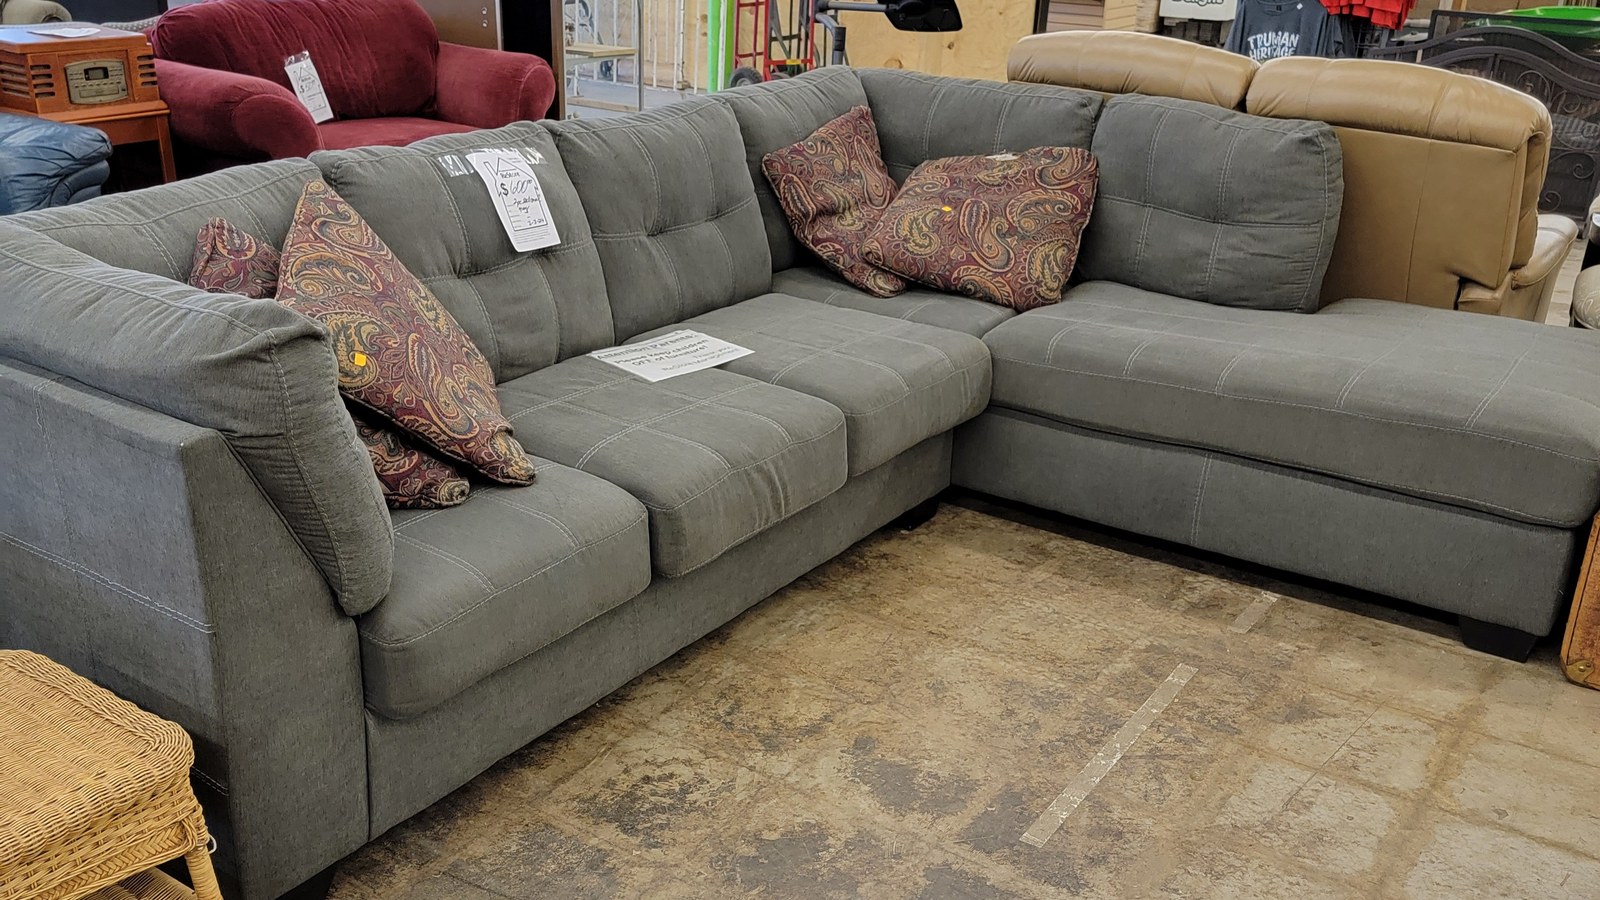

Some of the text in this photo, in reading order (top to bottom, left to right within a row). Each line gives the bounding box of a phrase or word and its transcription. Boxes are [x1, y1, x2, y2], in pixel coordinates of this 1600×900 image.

[1247, 31, 1300, 50] TRUMAN
[597, 346, 650, 360] Attention
[614, 339, 709, 364] Please keep children
